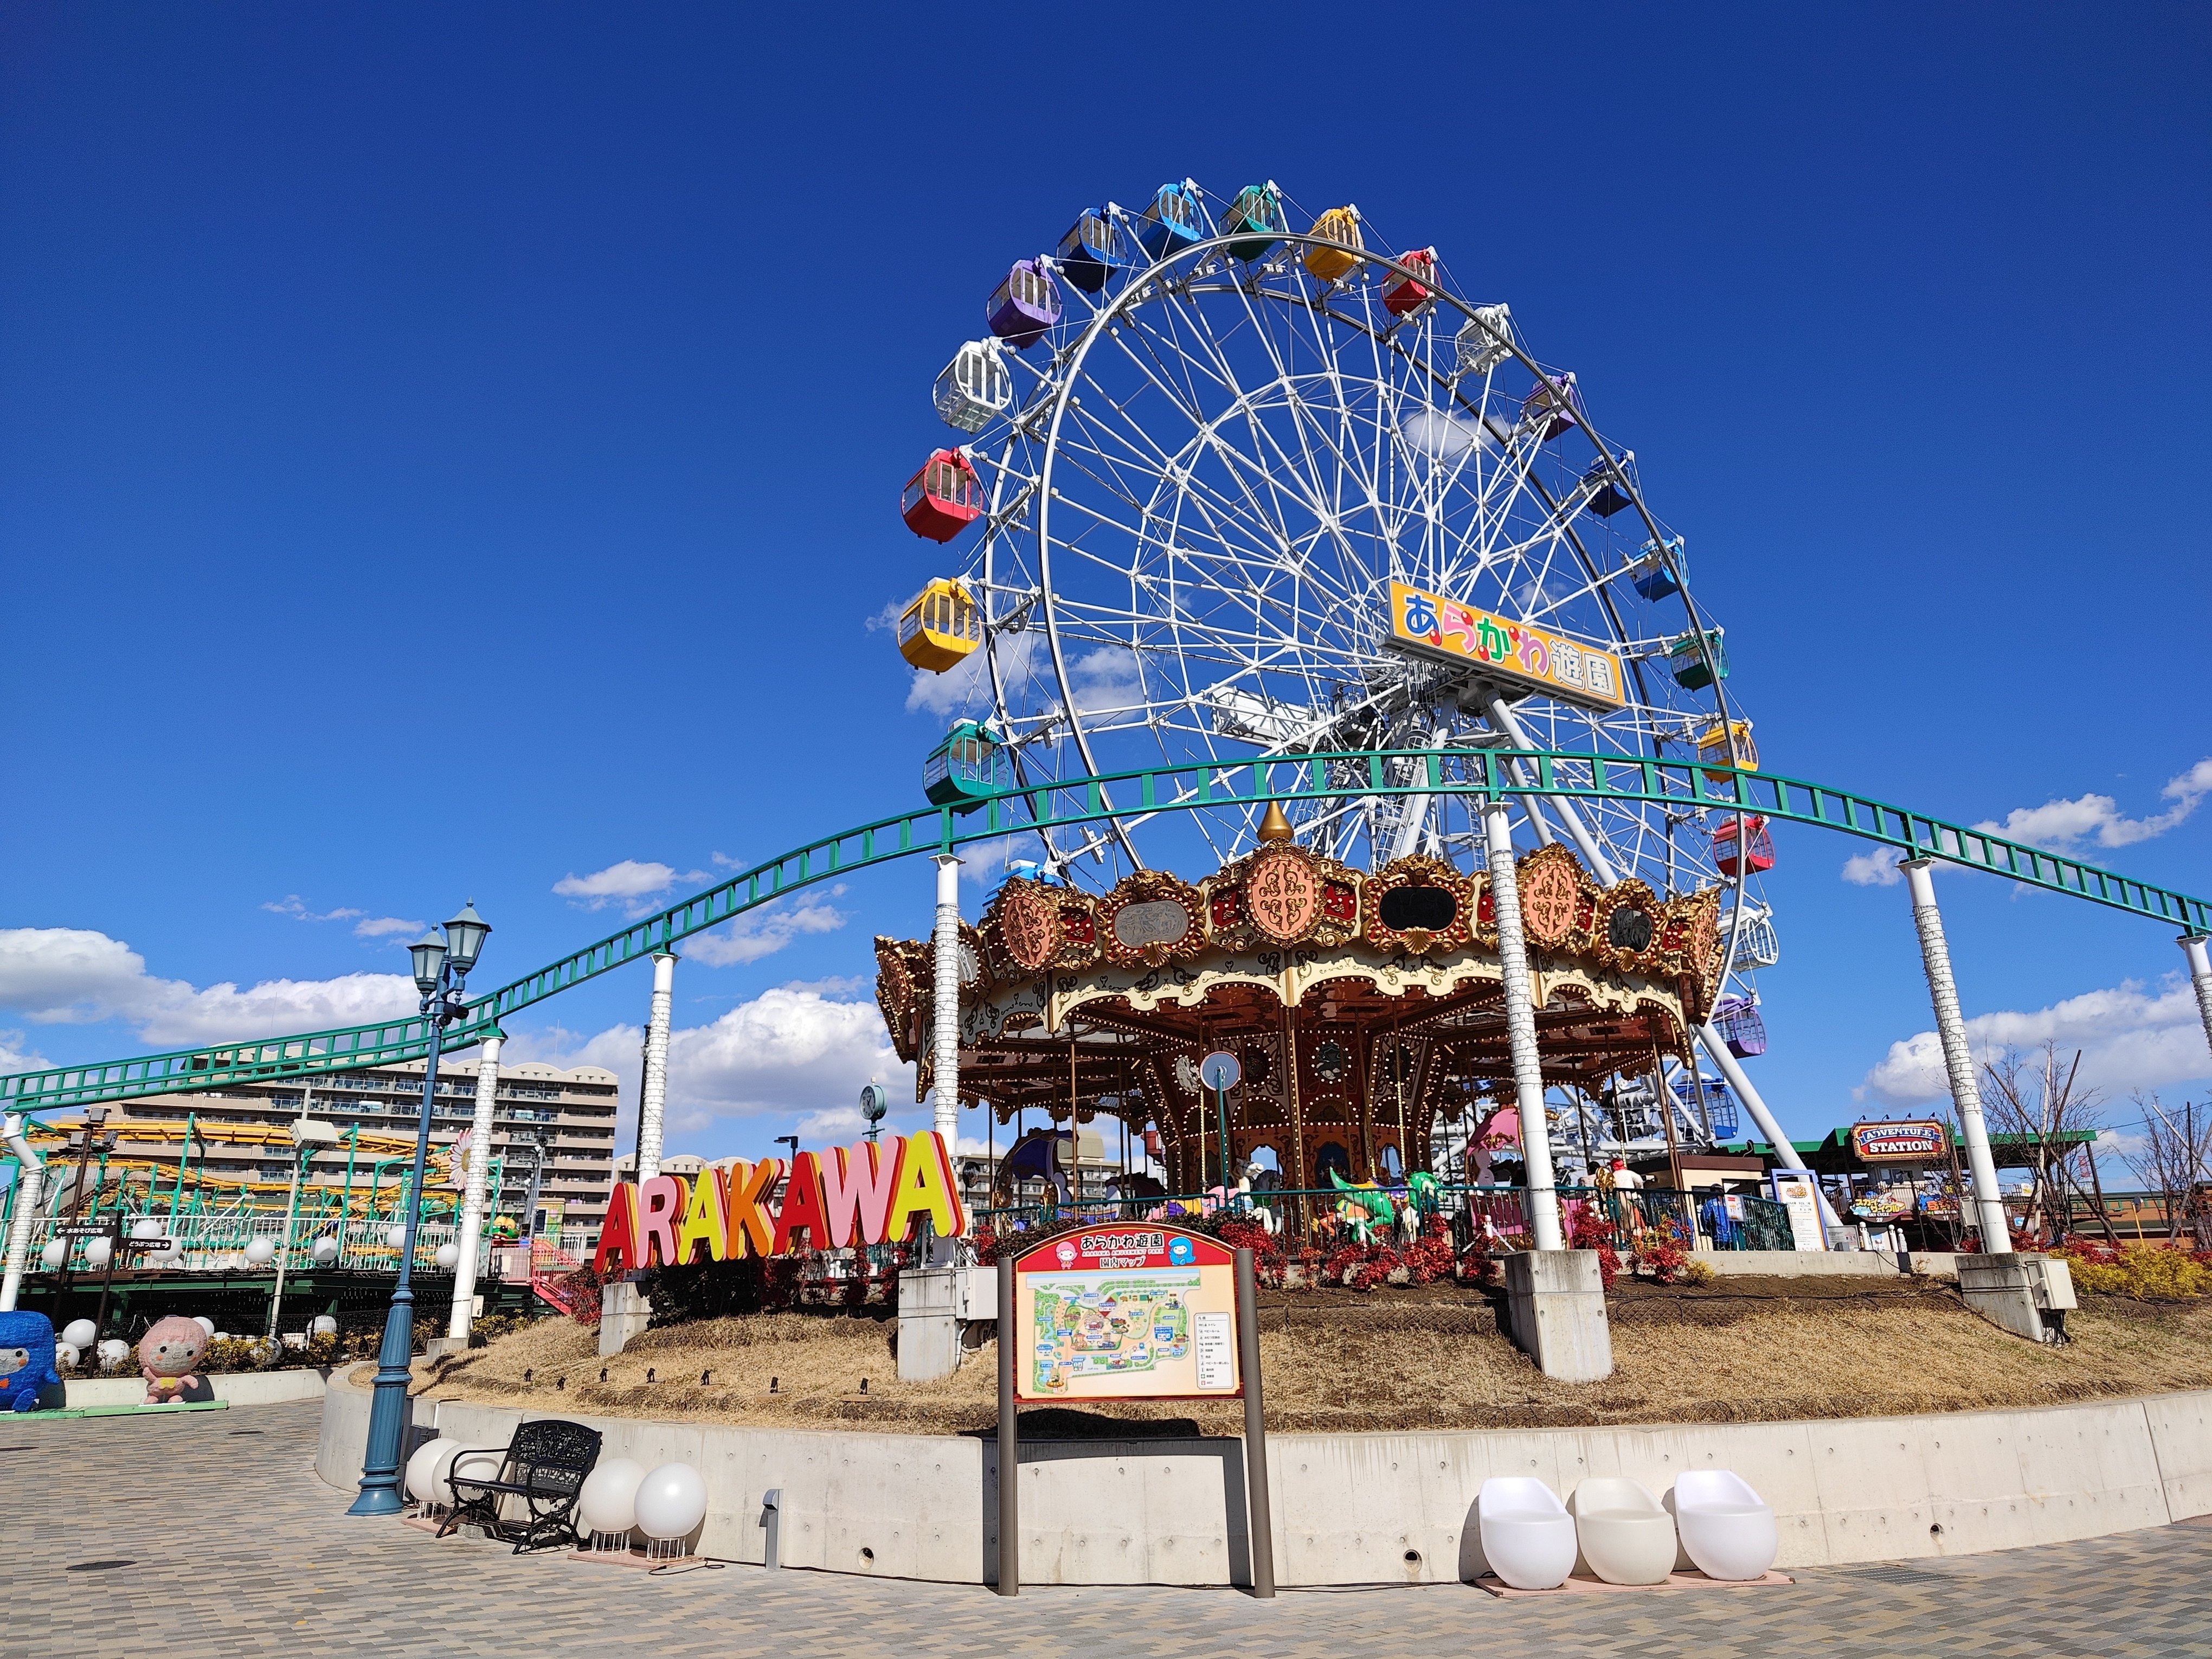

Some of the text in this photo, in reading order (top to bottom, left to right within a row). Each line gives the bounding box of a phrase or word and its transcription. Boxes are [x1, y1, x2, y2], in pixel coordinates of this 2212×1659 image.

[1403, 591, 1618, 699] あらかわ遊園
[1867, 1128, 1932, 1140] ADVENTURE
[1869, 1140, 1933, 1153] STATION
[593, 1130, 964, 1273] ARAKAWA
[1870, 1205, 1900, 1213] サイクル
[1081, 1233, 1163, 1249] あらかわ遊園
[1101, 1257, 1145, 1268] 園内マップ
